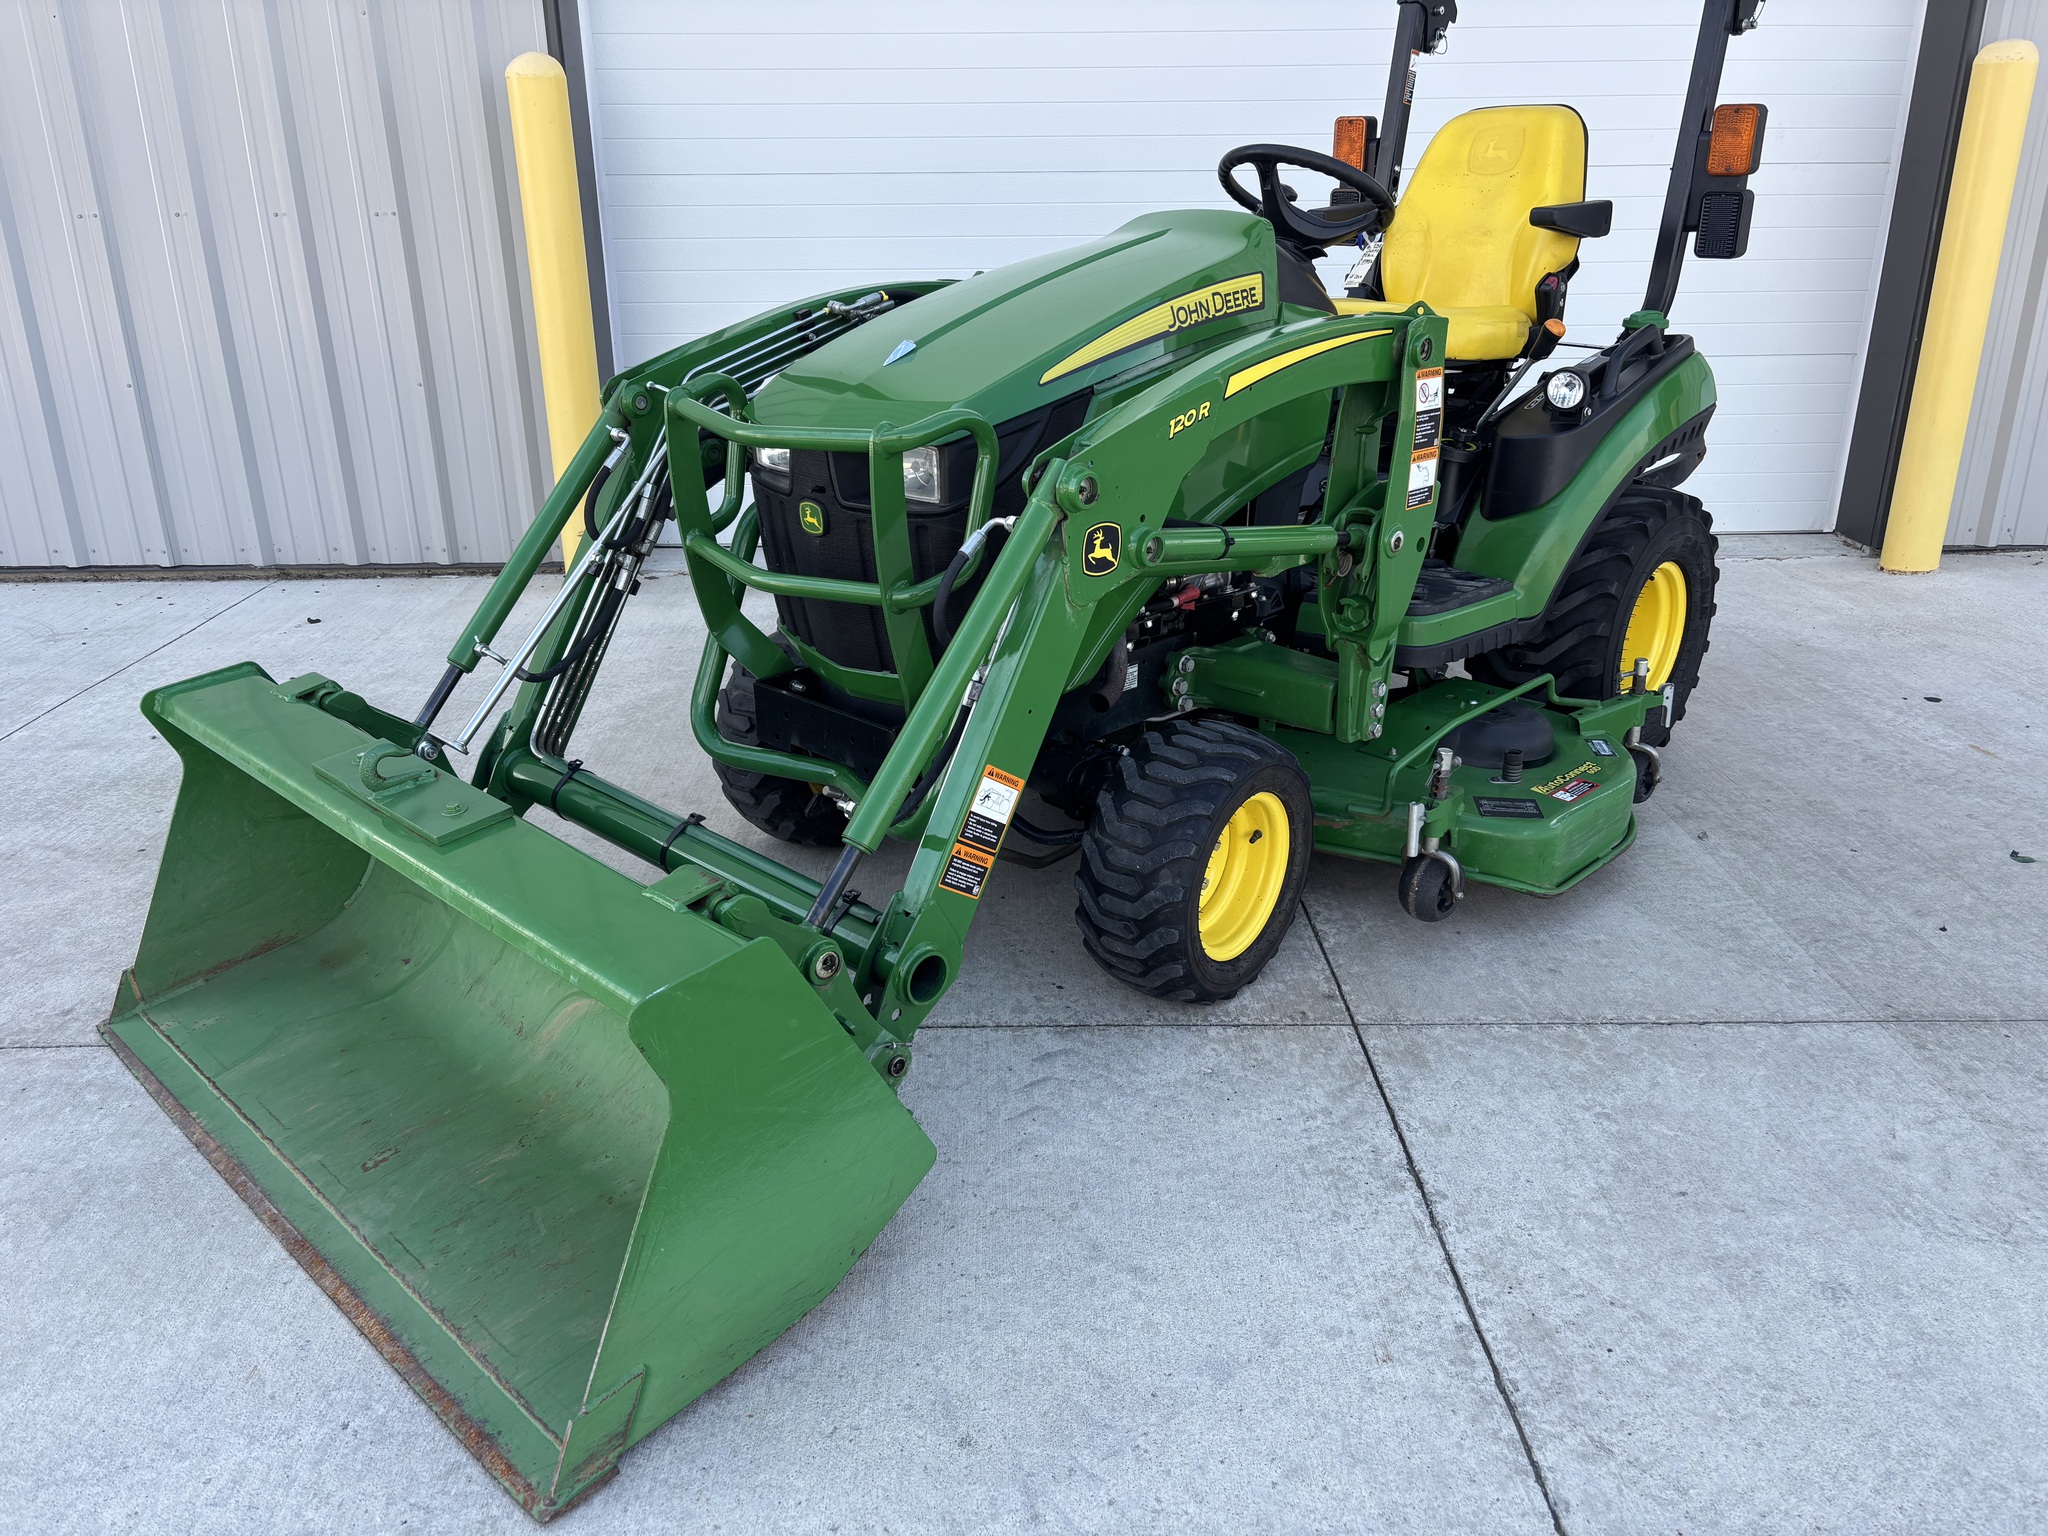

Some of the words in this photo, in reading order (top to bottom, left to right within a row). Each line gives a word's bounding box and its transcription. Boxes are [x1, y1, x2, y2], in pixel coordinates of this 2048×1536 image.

[1168, 298, 1211, 329] JOHN
[1211, 286, 1258, 315] DEERE
[1421, 367, 1442, 378] WARNING
[1416, 449, 1437, 462] WARNING
[994, 770, 1019, 788] WARNING
[1539, 761, 1597, 793] AutoConnect
[963, 849, 989, 866] WARNING
